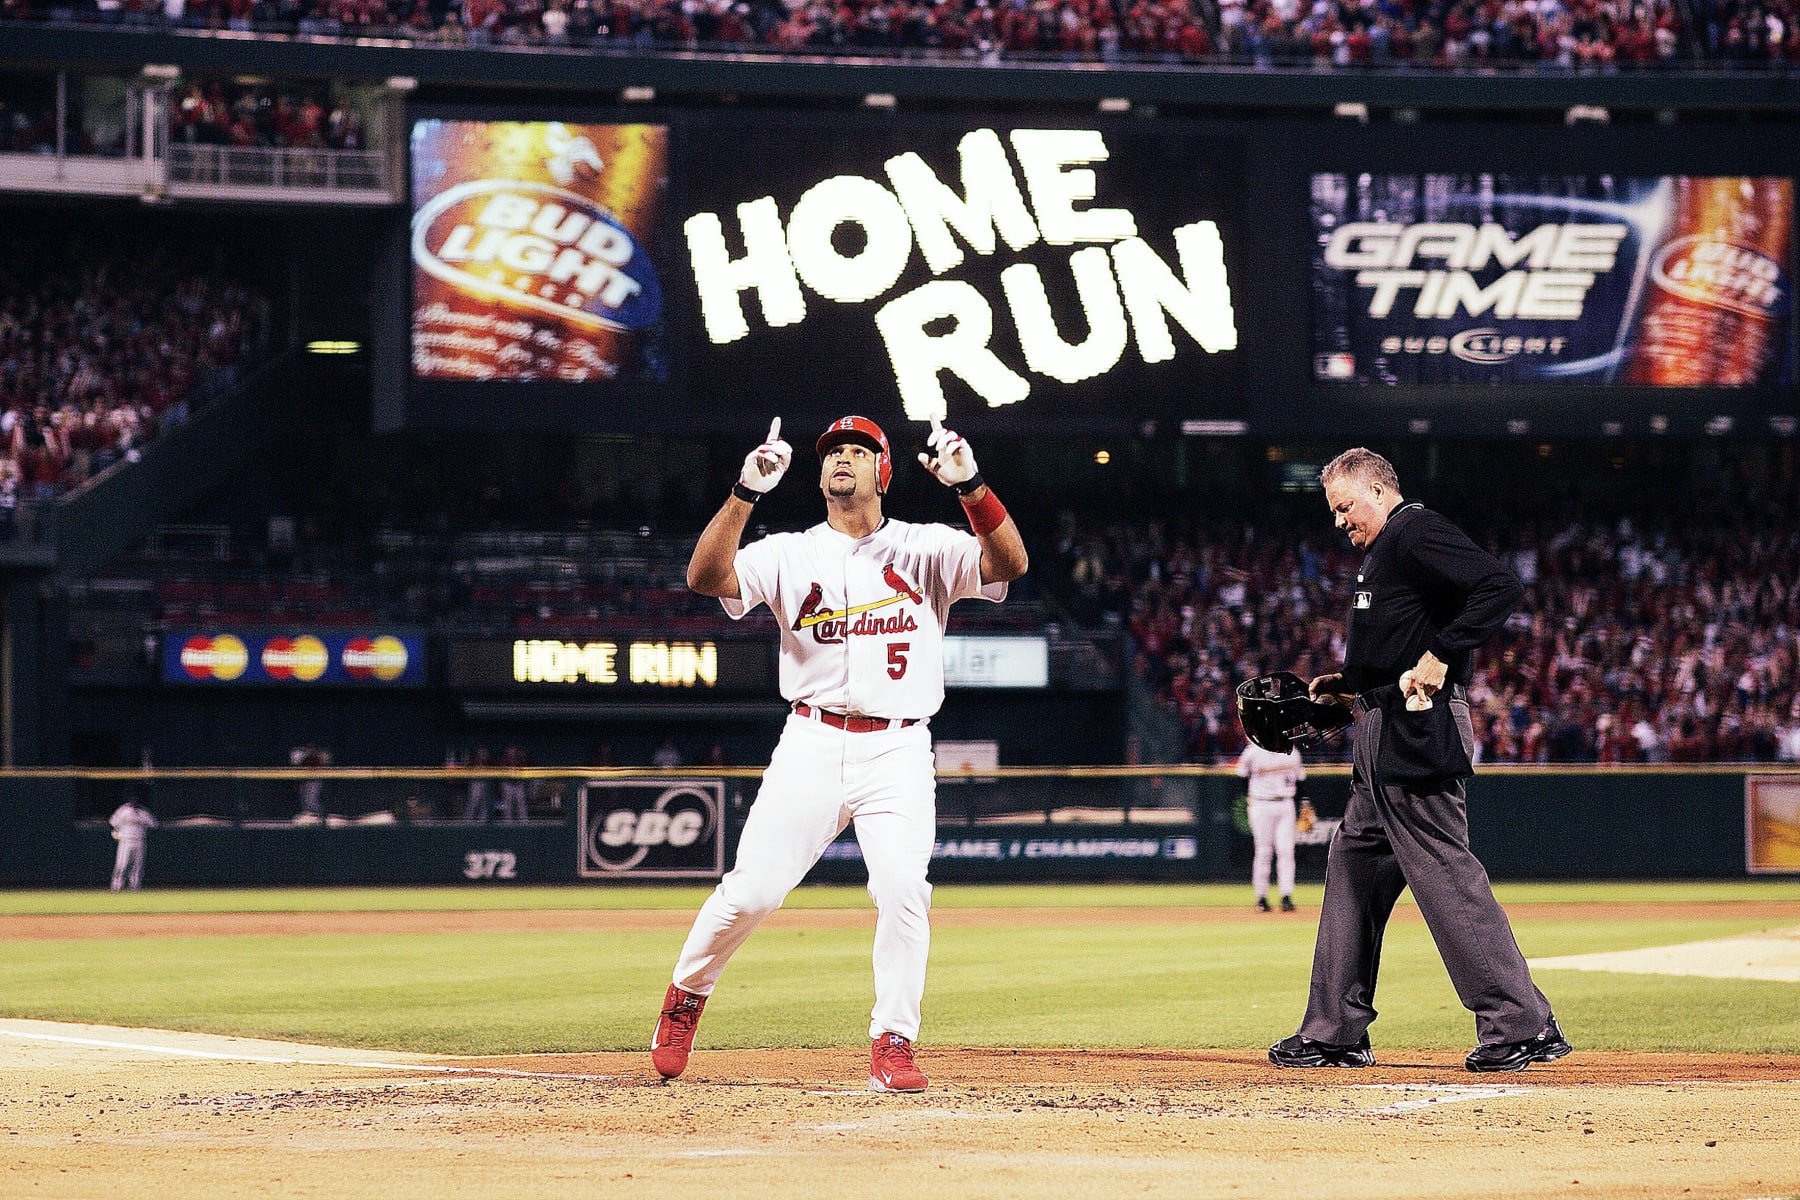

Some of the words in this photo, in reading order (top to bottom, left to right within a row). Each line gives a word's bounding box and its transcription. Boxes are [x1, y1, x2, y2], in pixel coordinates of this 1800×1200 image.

[477, 193, 634, 267] BUD
[684, 128, 1138, 343] HOME
[1324, 222, 1628, 271] GAME
[437, 224, 642, 309] LIGHT
[1355, 270, 1595, 320] TIME
[875, 220, 1238, 421] RUN
[812, 607, 918, 645] Cardinals
[513, 639, 618, 684] HOME
[629, 641, 718, 687] RUN
[886, 642, 911, 681] 5
[599, 809, 704, 847] SBC
[463, 851, 517, 879] 372
